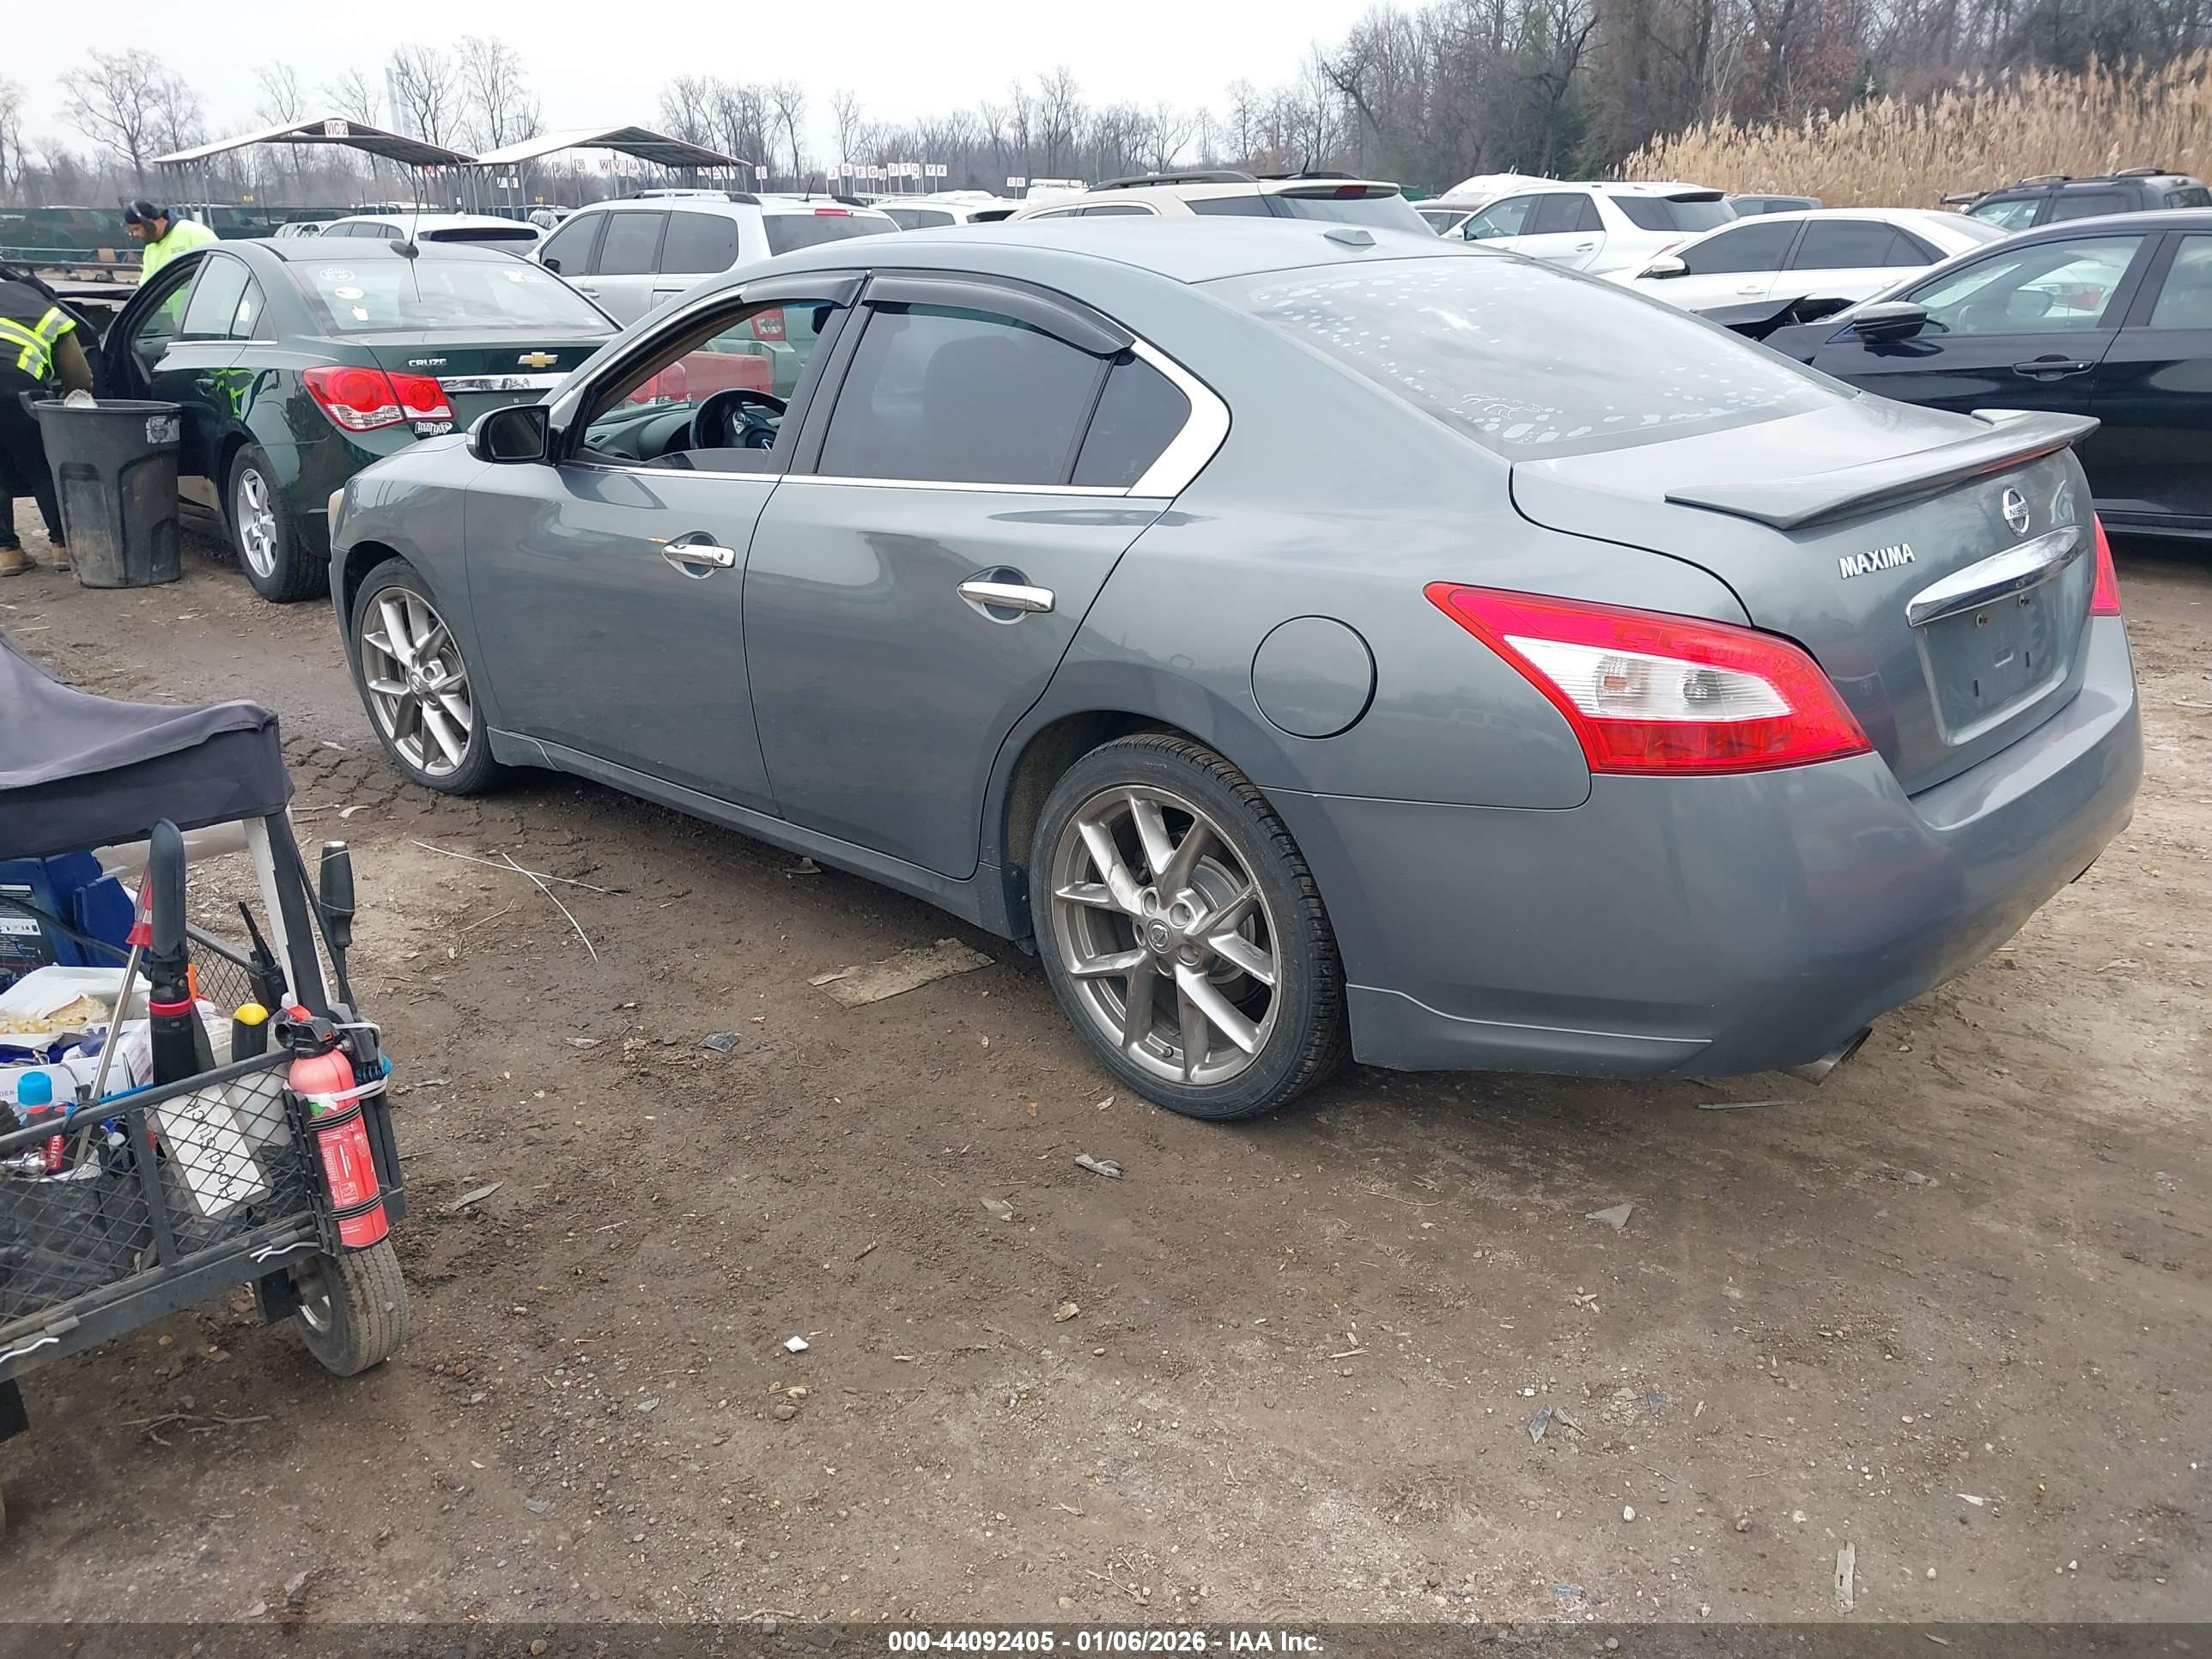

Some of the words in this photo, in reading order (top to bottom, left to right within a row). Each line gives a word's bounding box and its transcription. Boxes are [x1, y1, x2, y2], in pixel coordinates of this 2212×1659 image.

[325, 123, 340, 135] VIC
[342, 123, 347, 135] 2
[614, 161, 620, 170] V
[629, 162, 638, 171] AA
[870, 167, 877, 176] G
[408, 358, 447, 368] CRUZE
[1838, 543, 1916, 579] MAXIMA
